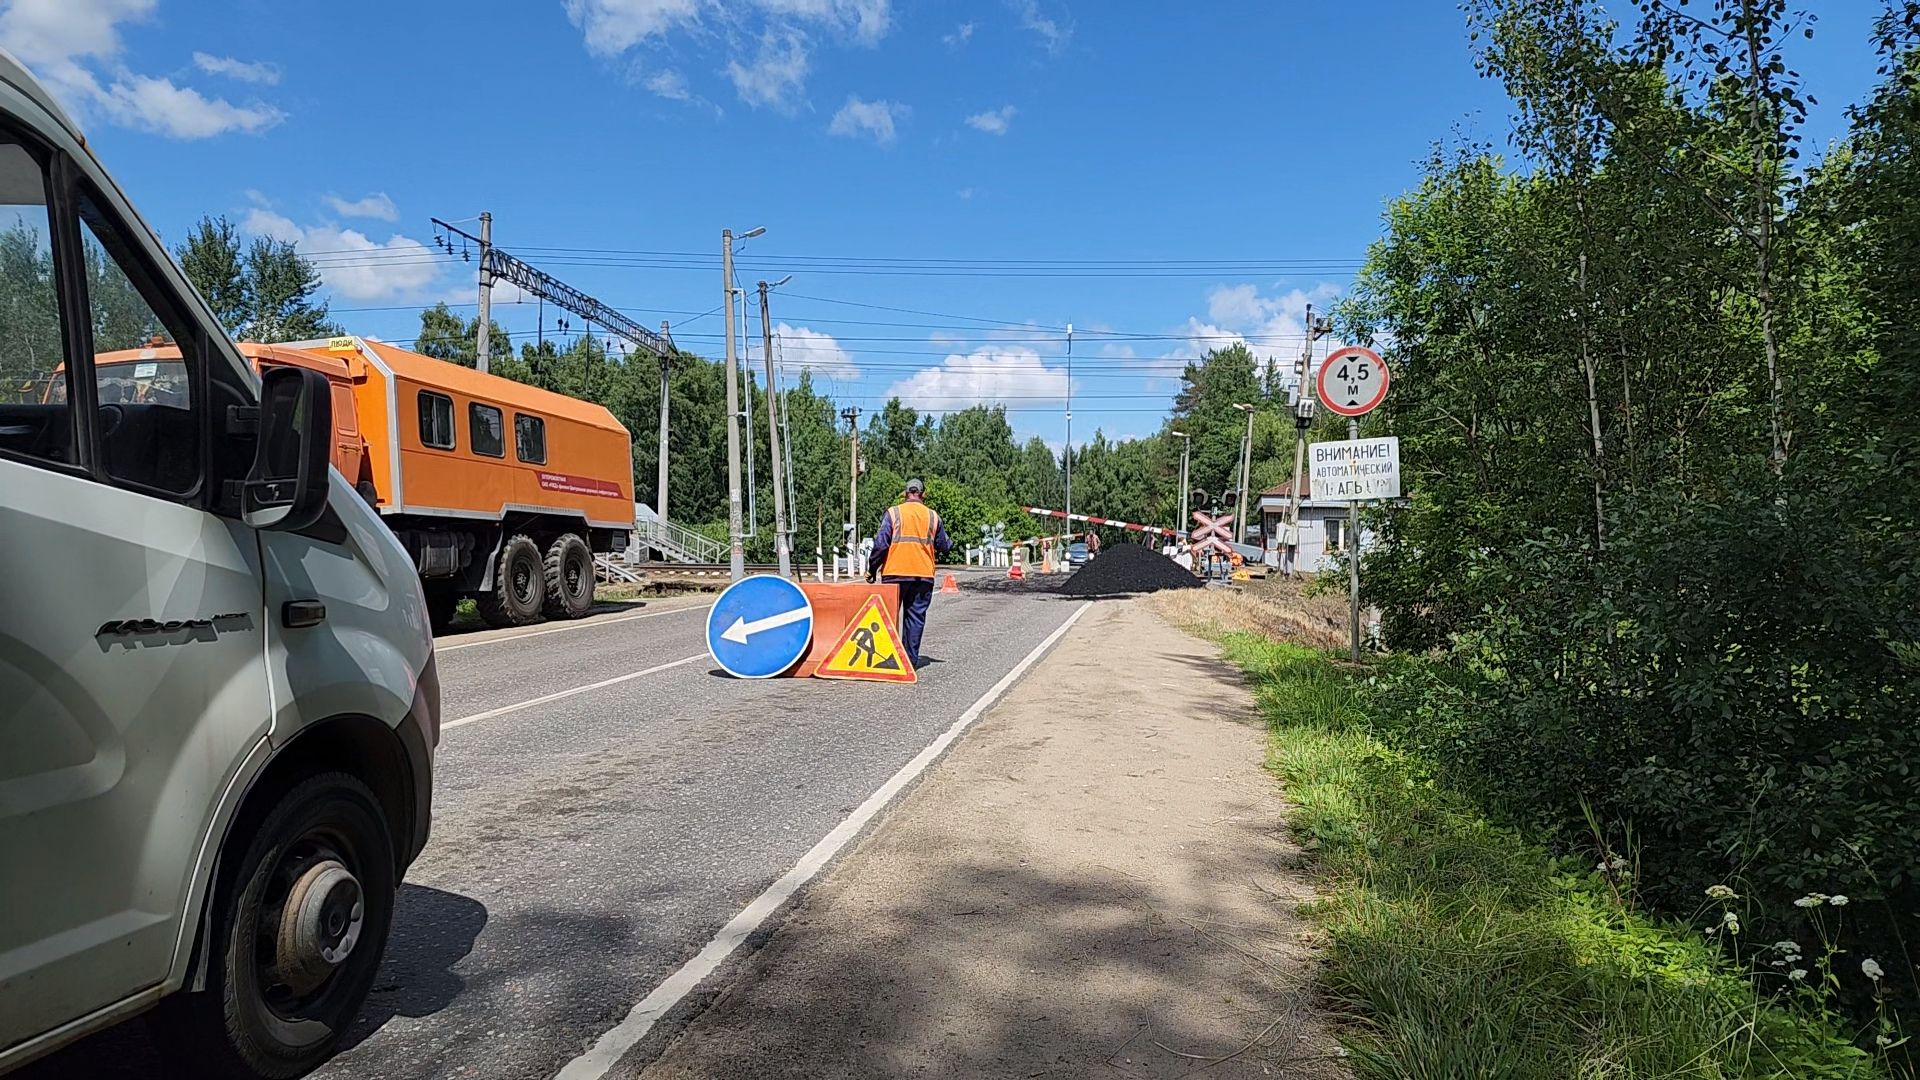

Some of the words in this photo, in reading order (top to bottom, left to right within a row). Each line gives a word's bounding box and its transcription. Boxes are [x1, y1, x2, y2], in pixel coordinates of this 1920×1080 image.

[330, 339, 353, 348] ЛЮДИ
[1337, 363, 1369, 384] 4,5
[1316, 443, 1390, 462] ВНИМАНИЕ!
[1316, 461, 1393, 478] АВТОМАТИЧЕСКИЙ
